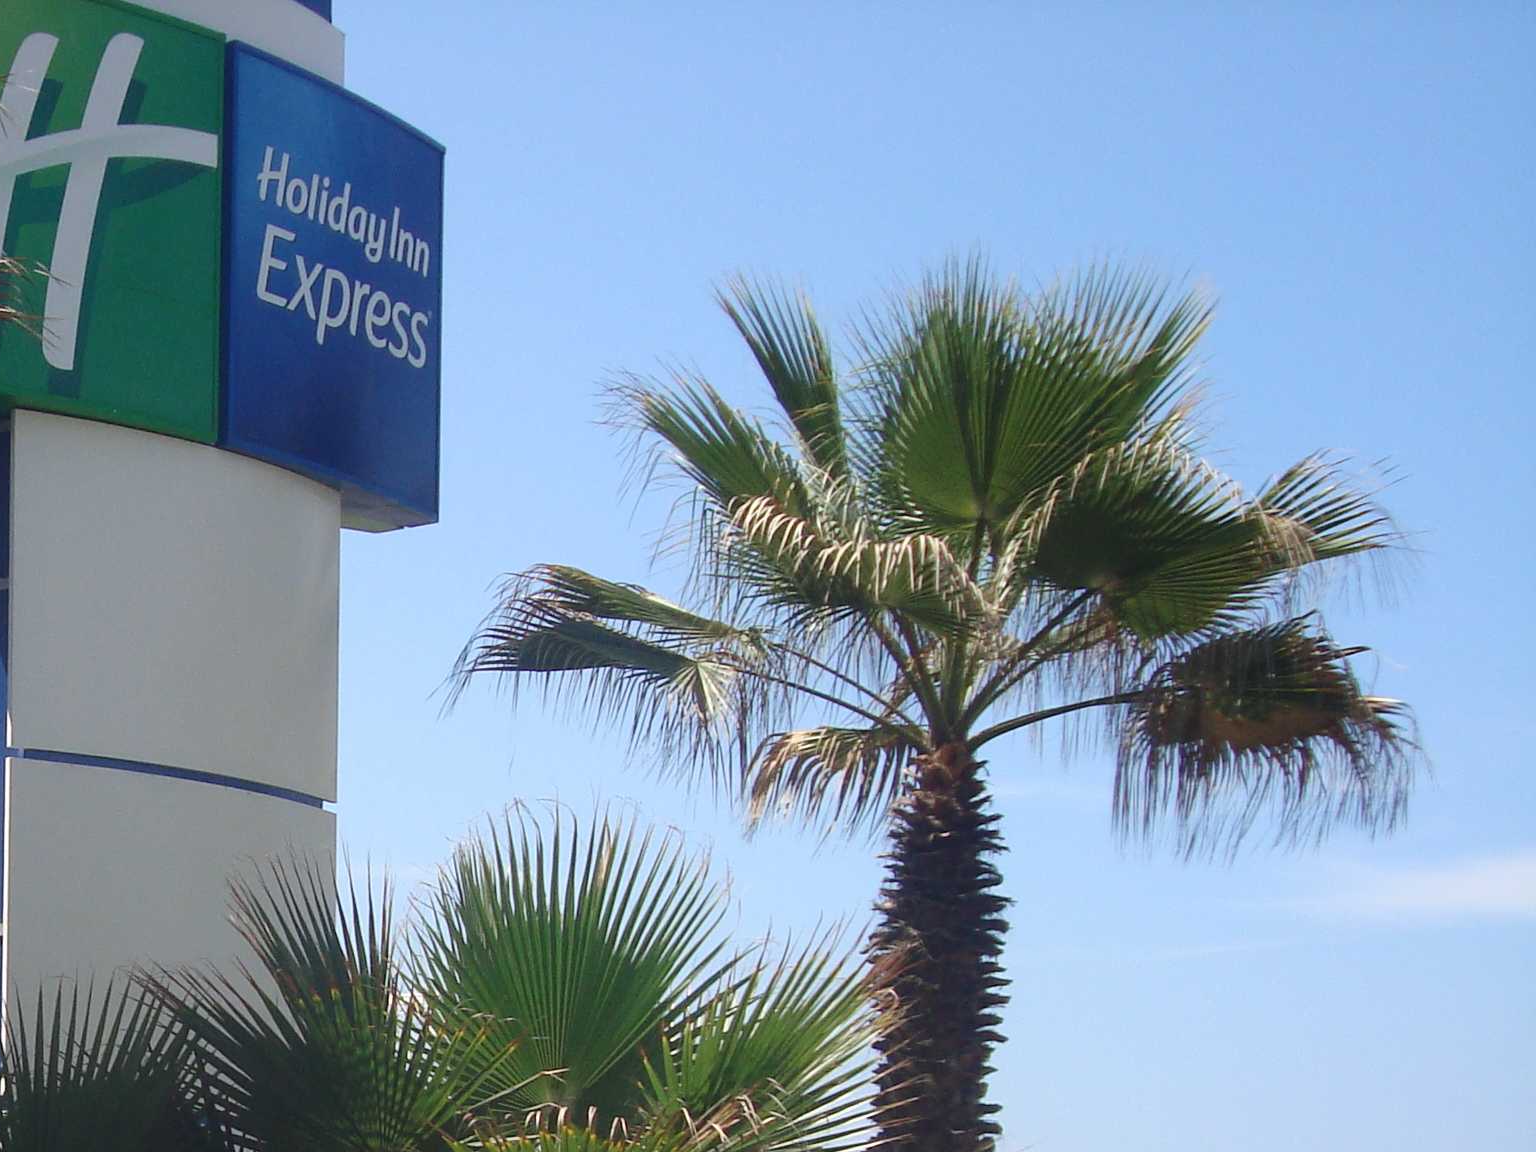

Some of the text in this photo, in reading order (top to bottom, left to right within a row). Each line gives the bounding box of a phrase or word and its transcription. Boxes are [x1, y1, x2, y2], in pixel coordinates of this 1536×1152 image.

[256, 145, 431, 278] Holiday Inn
[256, 223, 429, 369] Express
